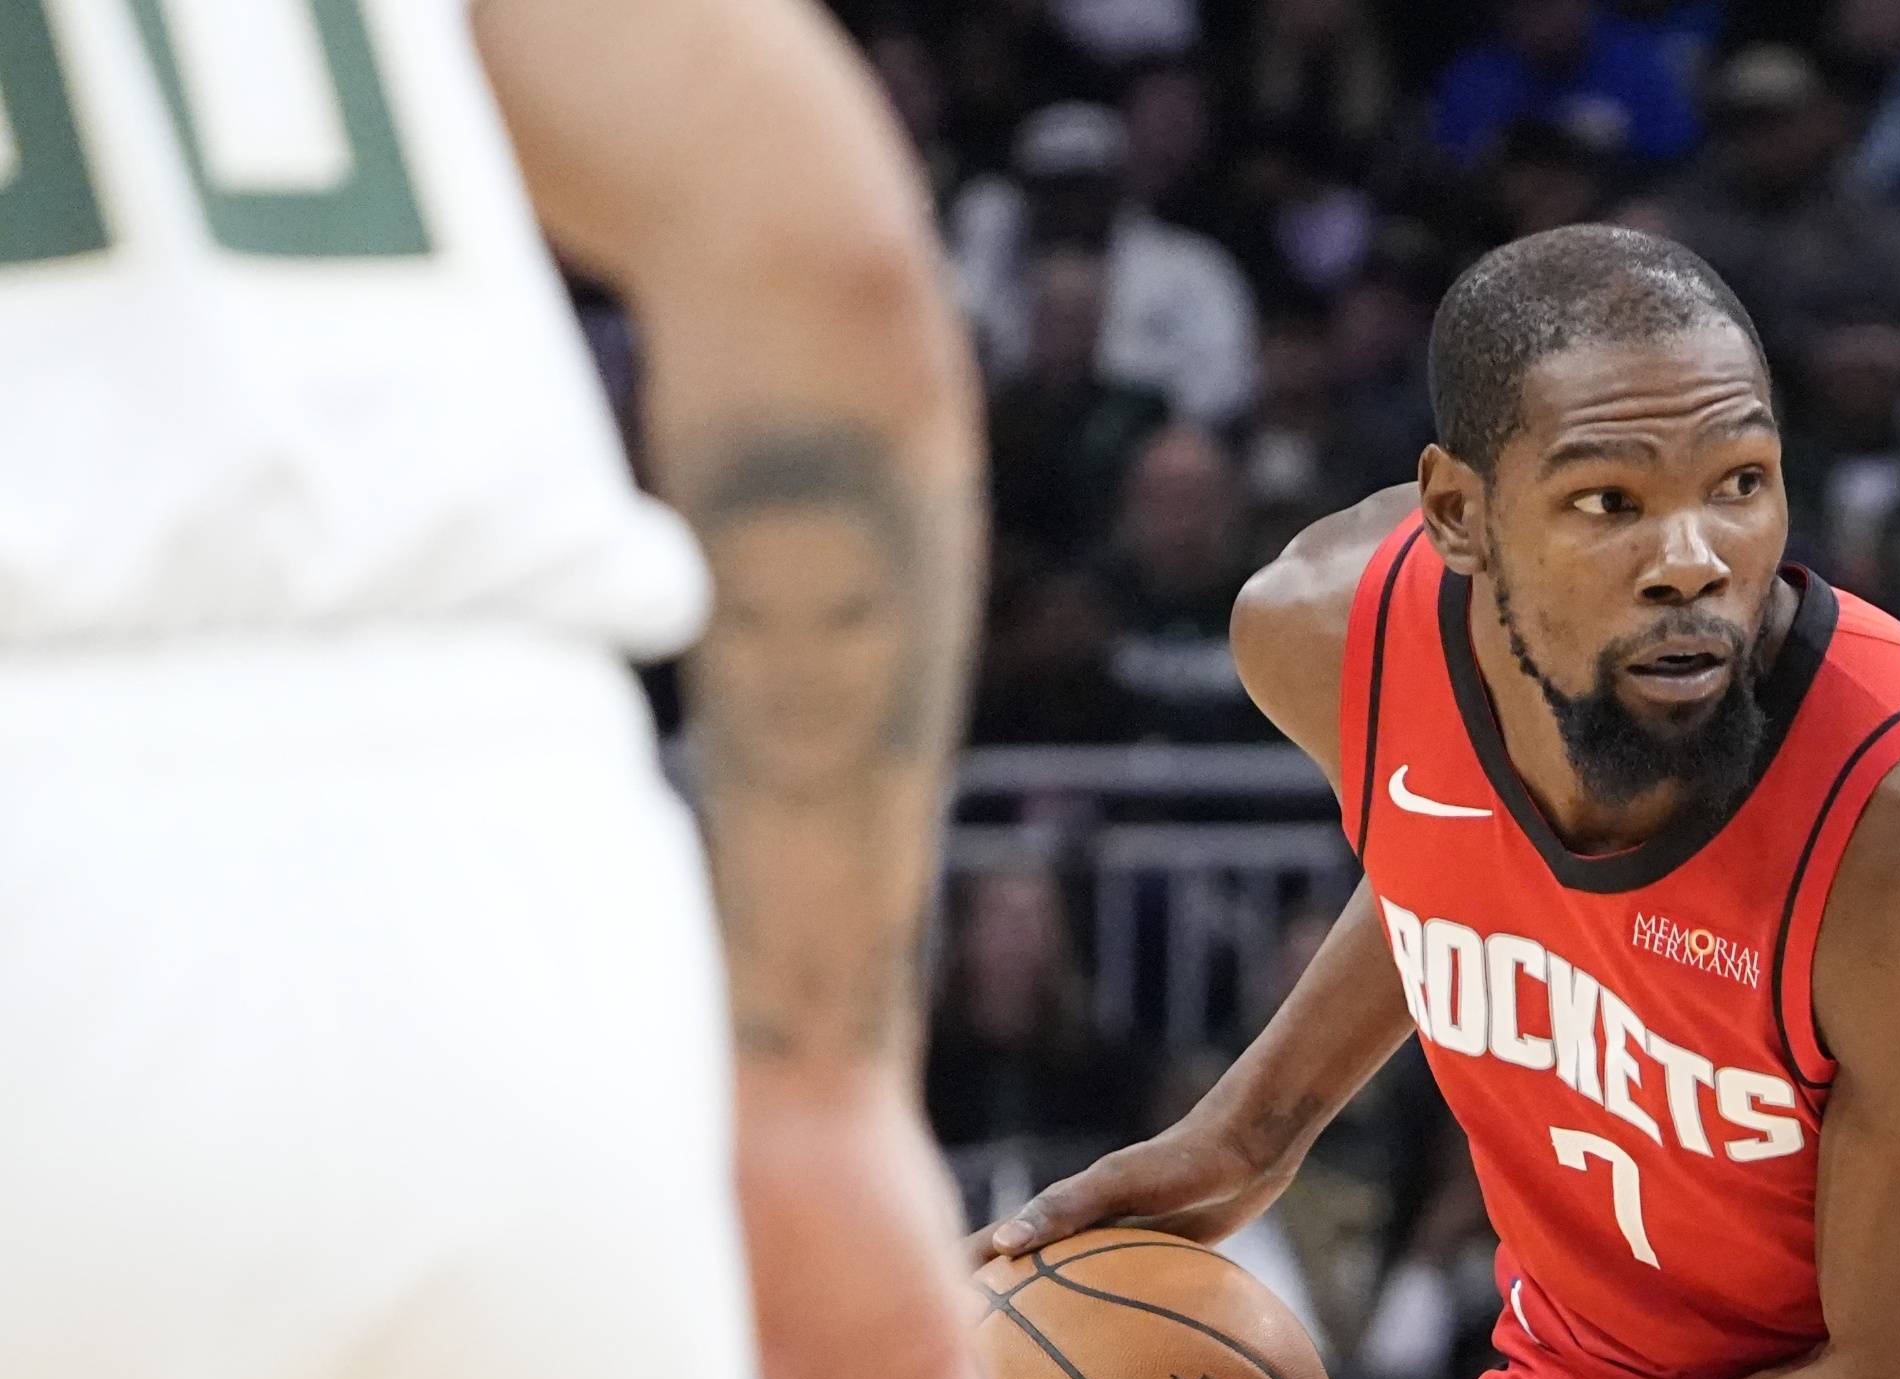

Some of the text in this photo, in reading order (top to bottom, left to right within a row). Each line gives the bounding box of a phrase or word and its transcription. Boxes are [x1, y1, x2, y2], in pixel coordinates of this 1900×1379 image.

[1632, 928, 1761, 990] HERMANN
[1633, 911, 1759, 974] MEMORIAL
[1379, 894, 1805, 1163] ROCKETS
[1549, 1125, 1662, 1271] 7
